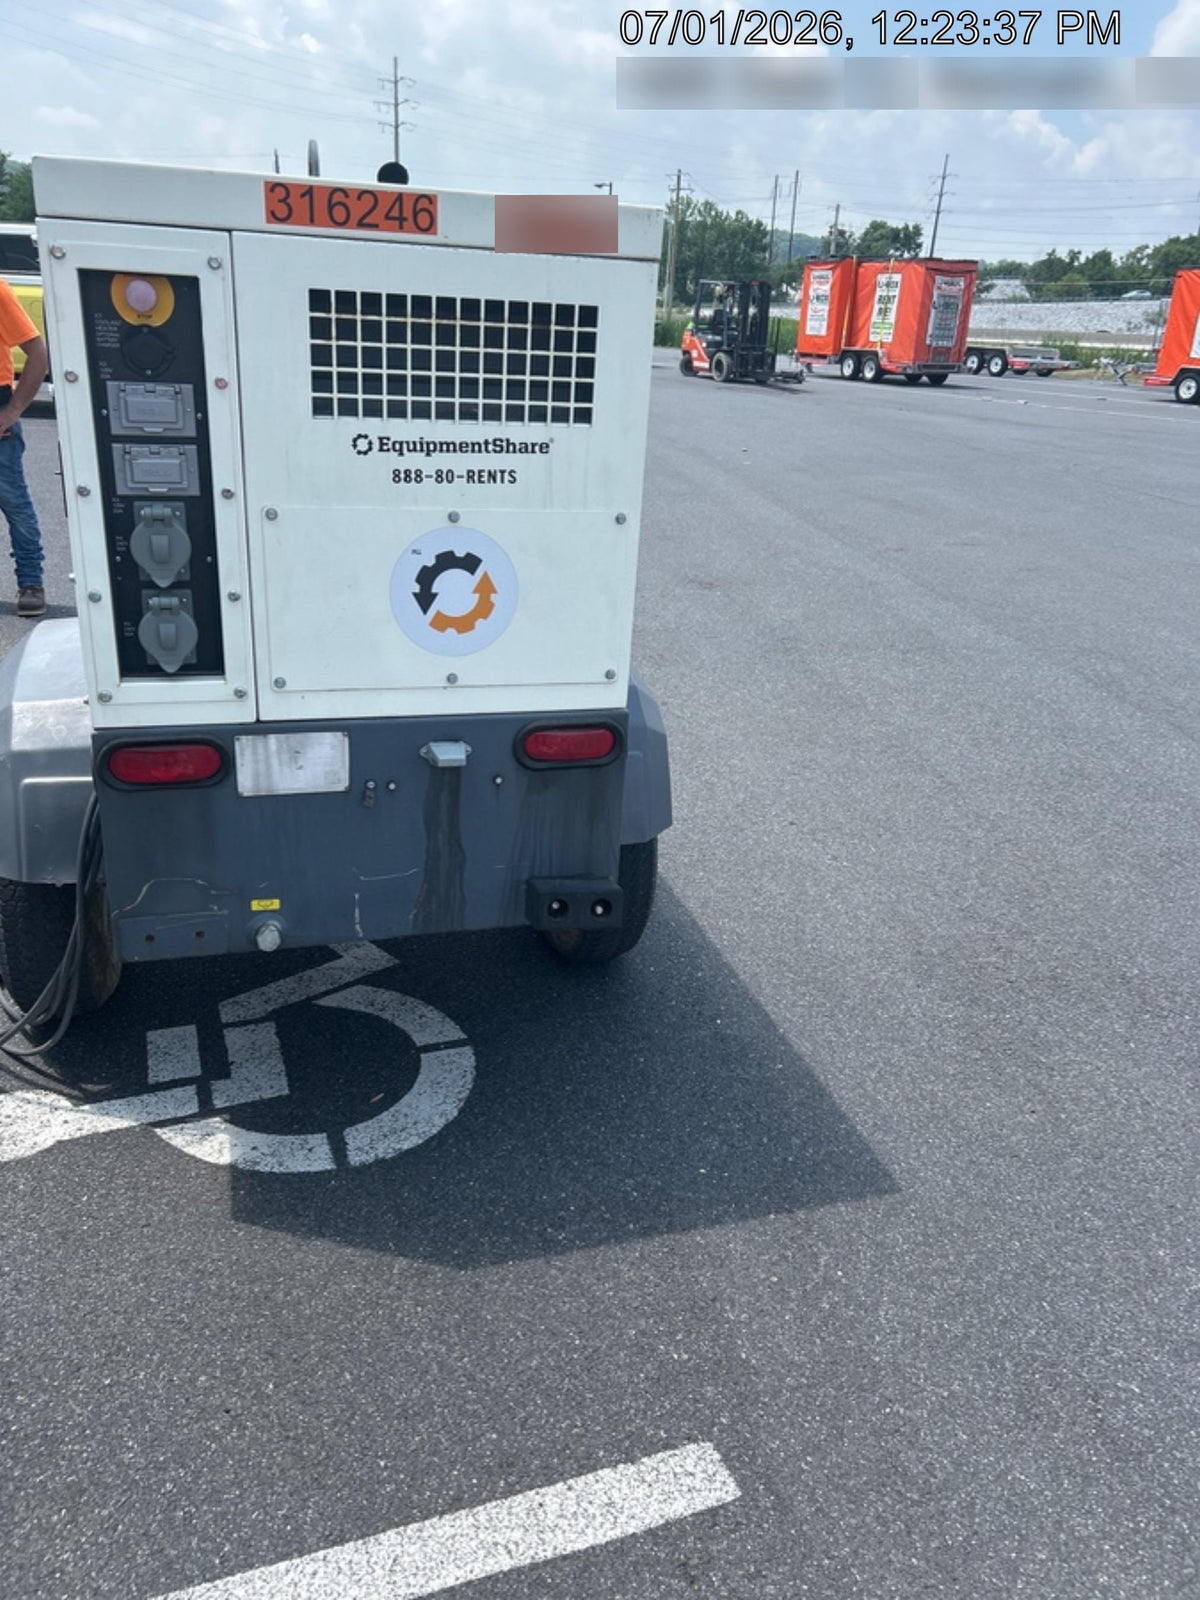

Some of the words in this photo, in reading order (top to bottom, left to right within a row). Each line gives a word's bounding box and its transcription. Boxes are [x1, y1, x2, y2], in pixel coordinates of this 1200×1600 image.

[268, 182, 435, 232] 316246
[377, 436, 551, 457] EquipmentShare
[391, 468, 518, 485] 888-80-RENTS
